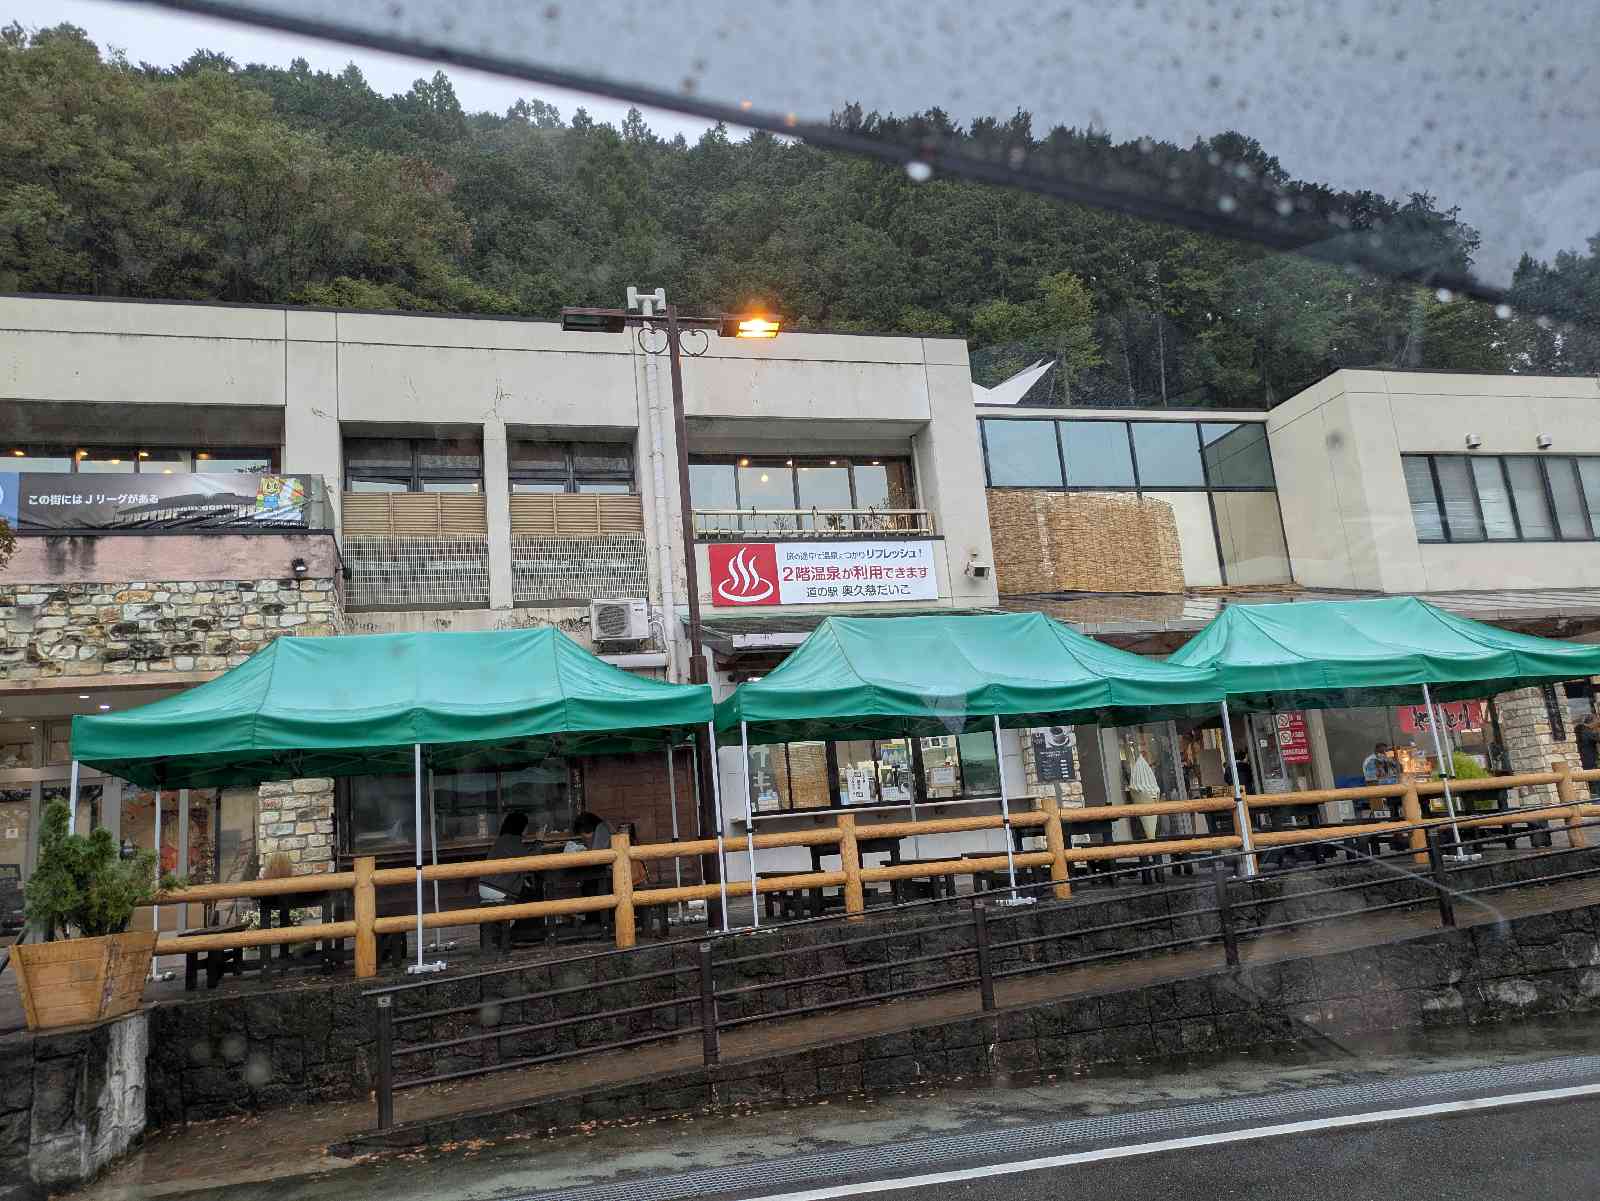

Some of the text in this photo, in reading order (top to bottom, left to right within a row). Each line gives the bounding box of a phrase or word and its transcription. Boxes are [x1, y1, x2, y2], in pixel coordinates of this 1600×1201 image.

[783, 565, 928, 582] 2階温泉が利用できます
